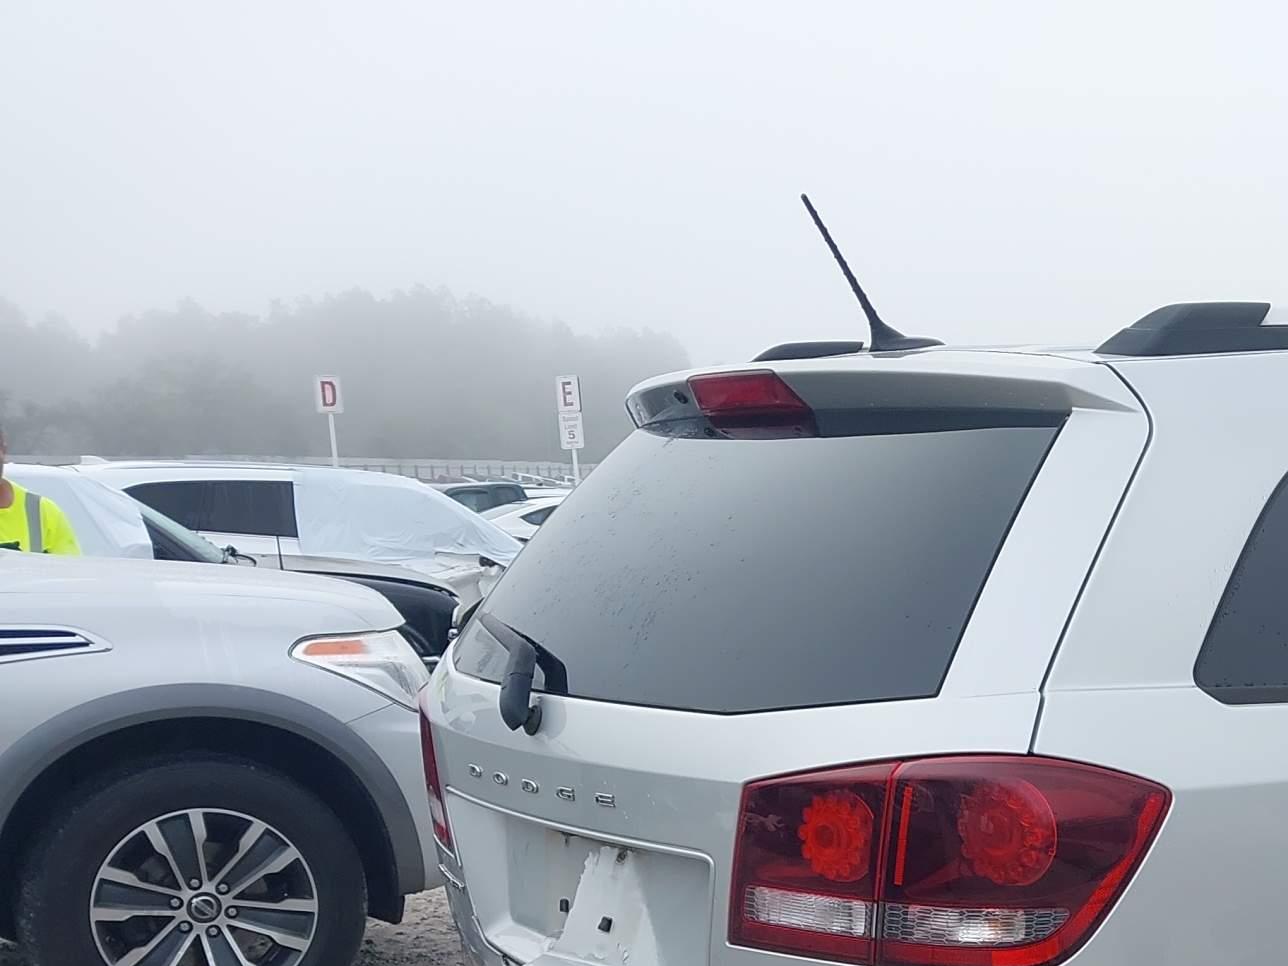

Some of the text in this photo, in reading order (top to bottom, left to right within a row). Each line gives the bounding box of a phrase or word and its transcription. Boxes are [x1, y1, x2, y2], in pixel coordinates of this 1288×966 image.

[320, 380, 337, 407] D
[561, 381, 574, 407] E
[567, 430, 576, 440] 5
[467, 762, 617, 809] DODGE
